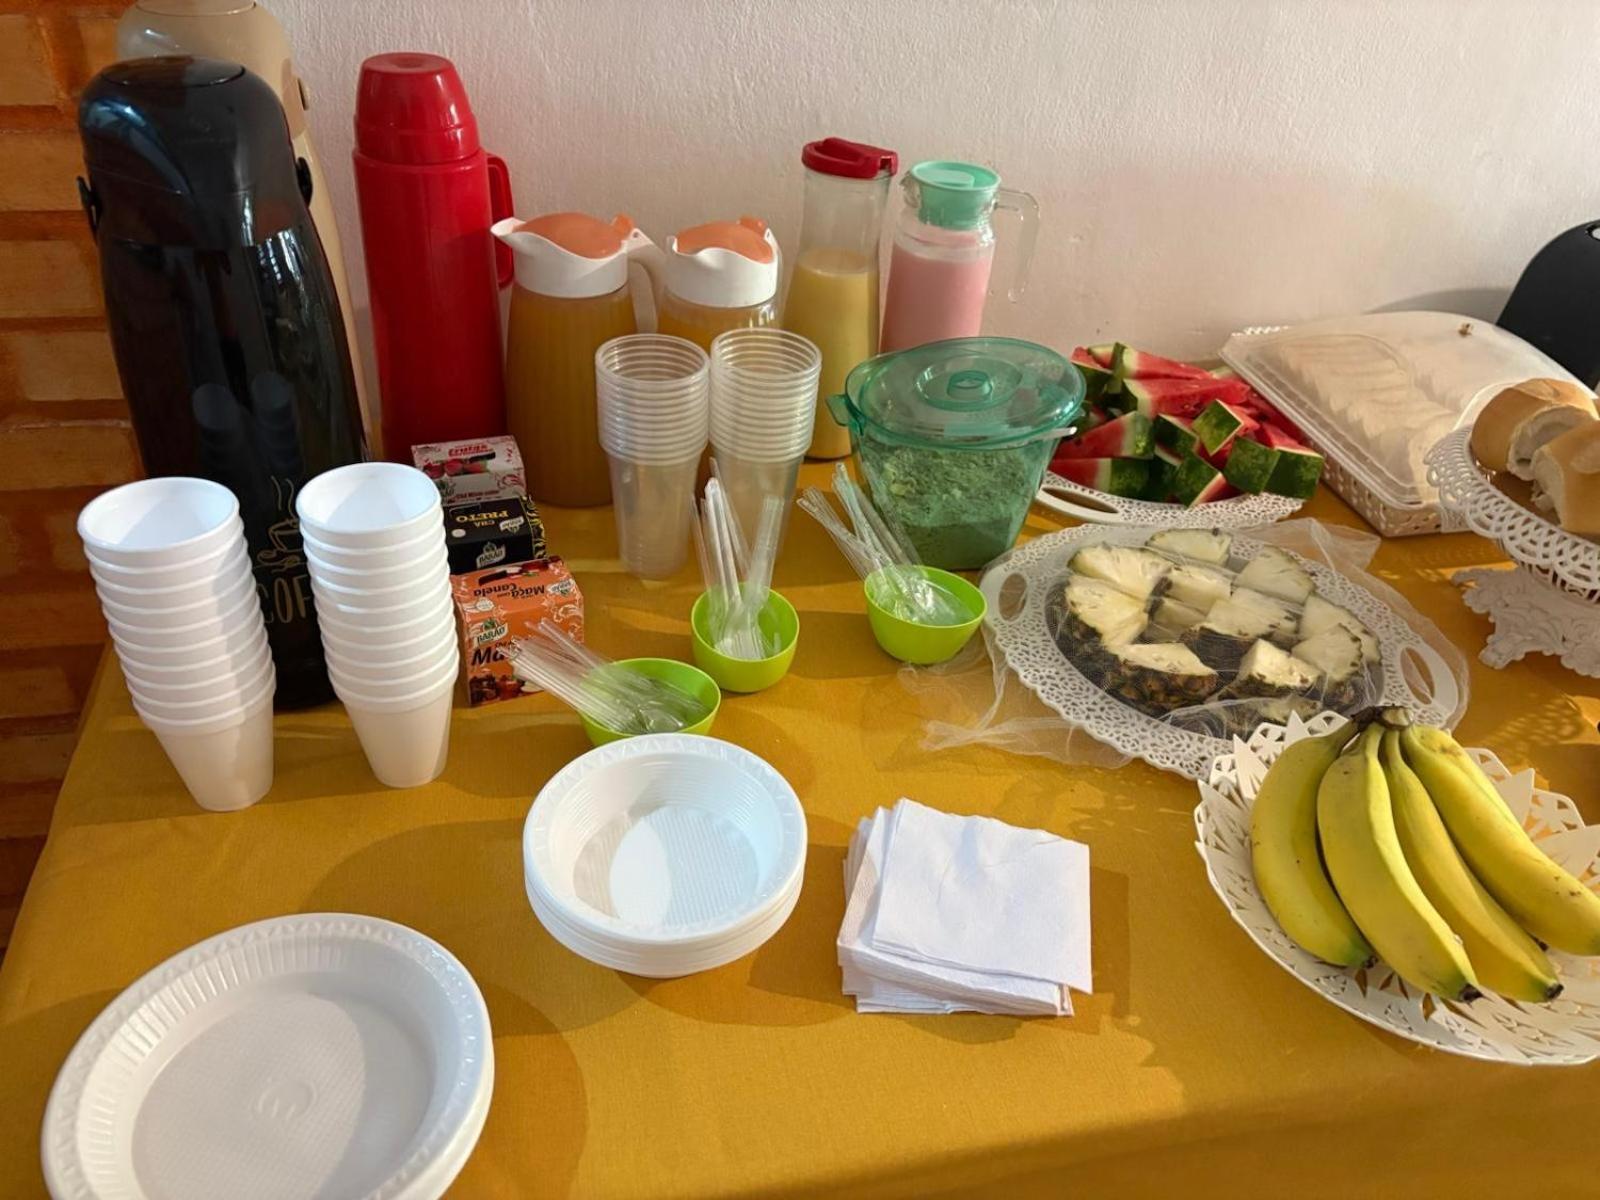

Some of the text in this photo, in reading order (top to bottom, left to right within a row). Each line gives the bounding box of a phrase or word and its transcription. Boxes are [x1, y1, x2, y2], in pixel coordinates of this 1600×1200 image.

[456, 510, 509, 523] PRETO
[473, 582, 518, 598] Canela
[471, 646, 505, 666] Ma
